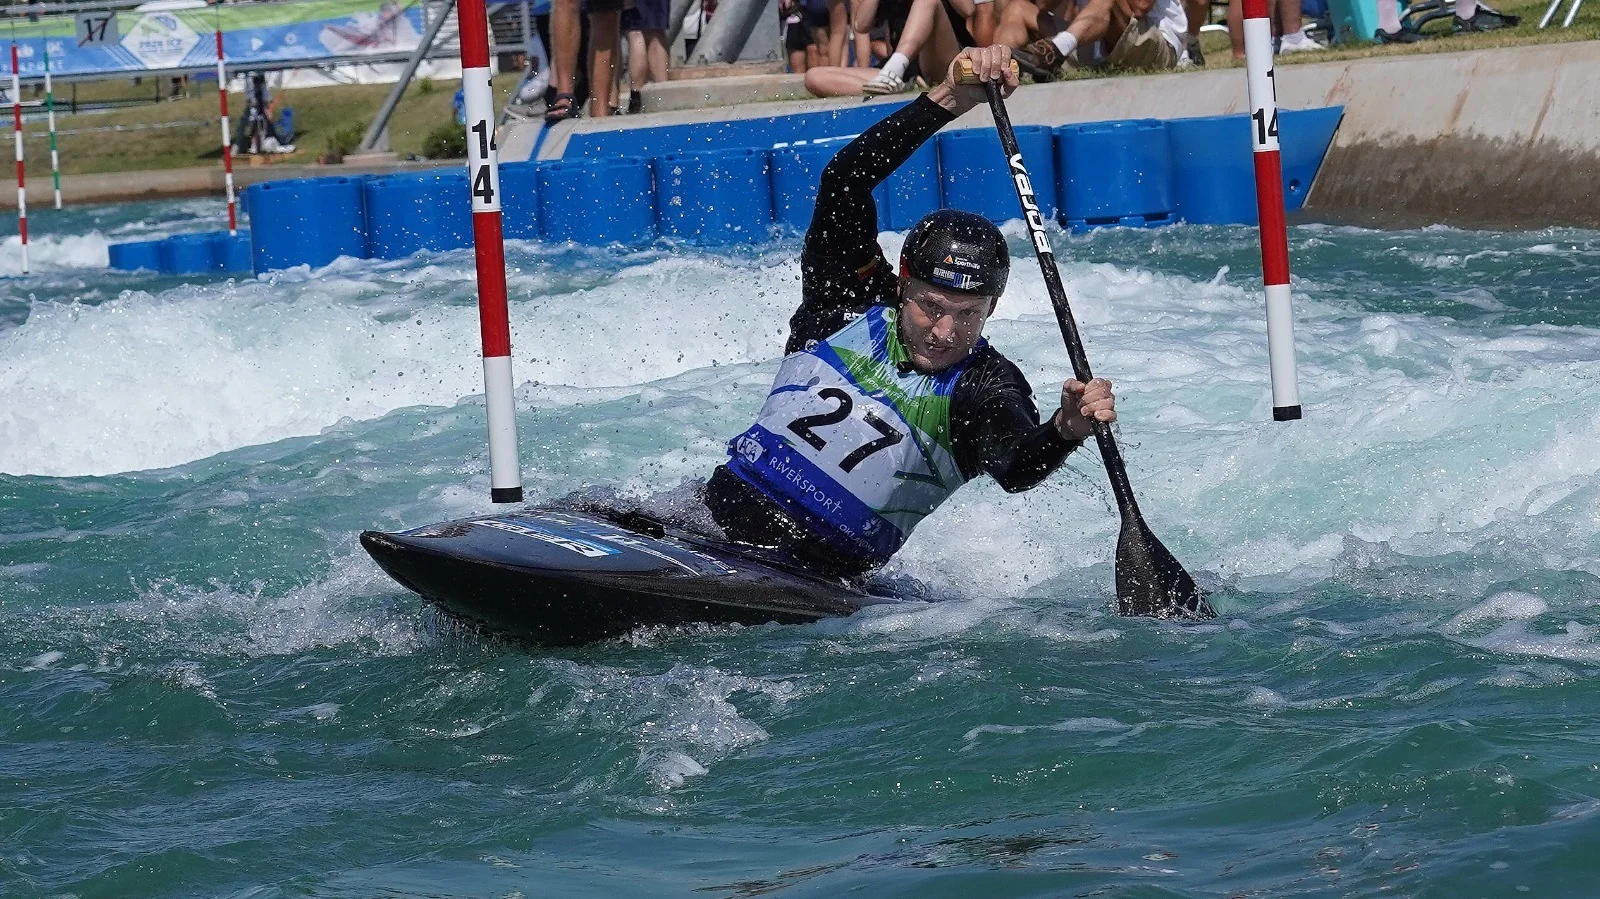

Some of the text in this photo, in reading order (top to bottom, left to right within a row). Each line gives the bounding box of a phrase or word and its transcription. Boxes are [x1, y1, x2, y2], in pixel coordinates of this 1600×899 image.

[83, 18, 110, 42] 17
[1252, 107, 1280, 145] 14
[787, 388, 904, 474] 27
[769, 456, 842, 513] RIVERSPORT
